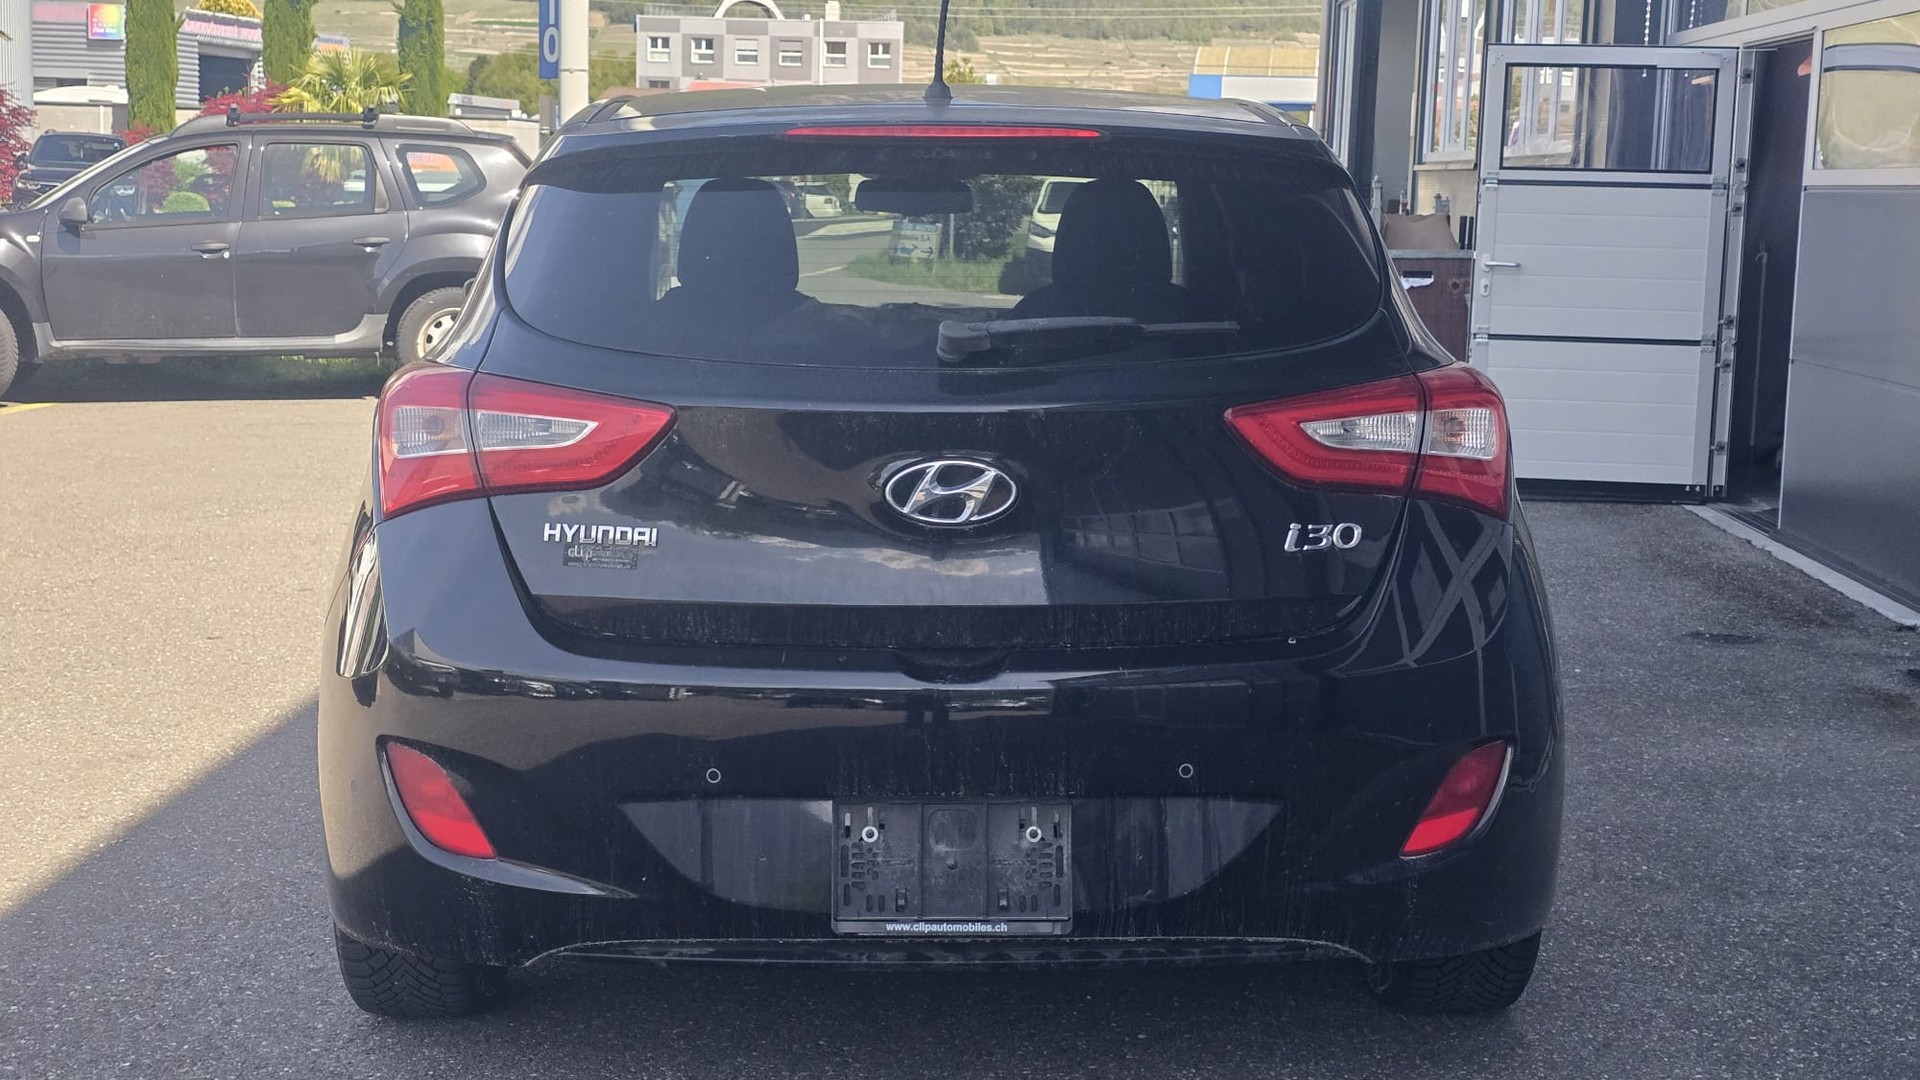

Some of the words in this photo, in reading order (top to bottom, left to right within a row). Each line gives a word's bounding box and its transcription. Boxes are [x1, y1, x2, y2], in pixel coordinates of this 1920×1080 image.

[542, 522, 658, 547] HYUNDAI
[1284, 522, 1363, 552] i30
[885, 922, 1008, 933] www.clipautomobiles.ch
